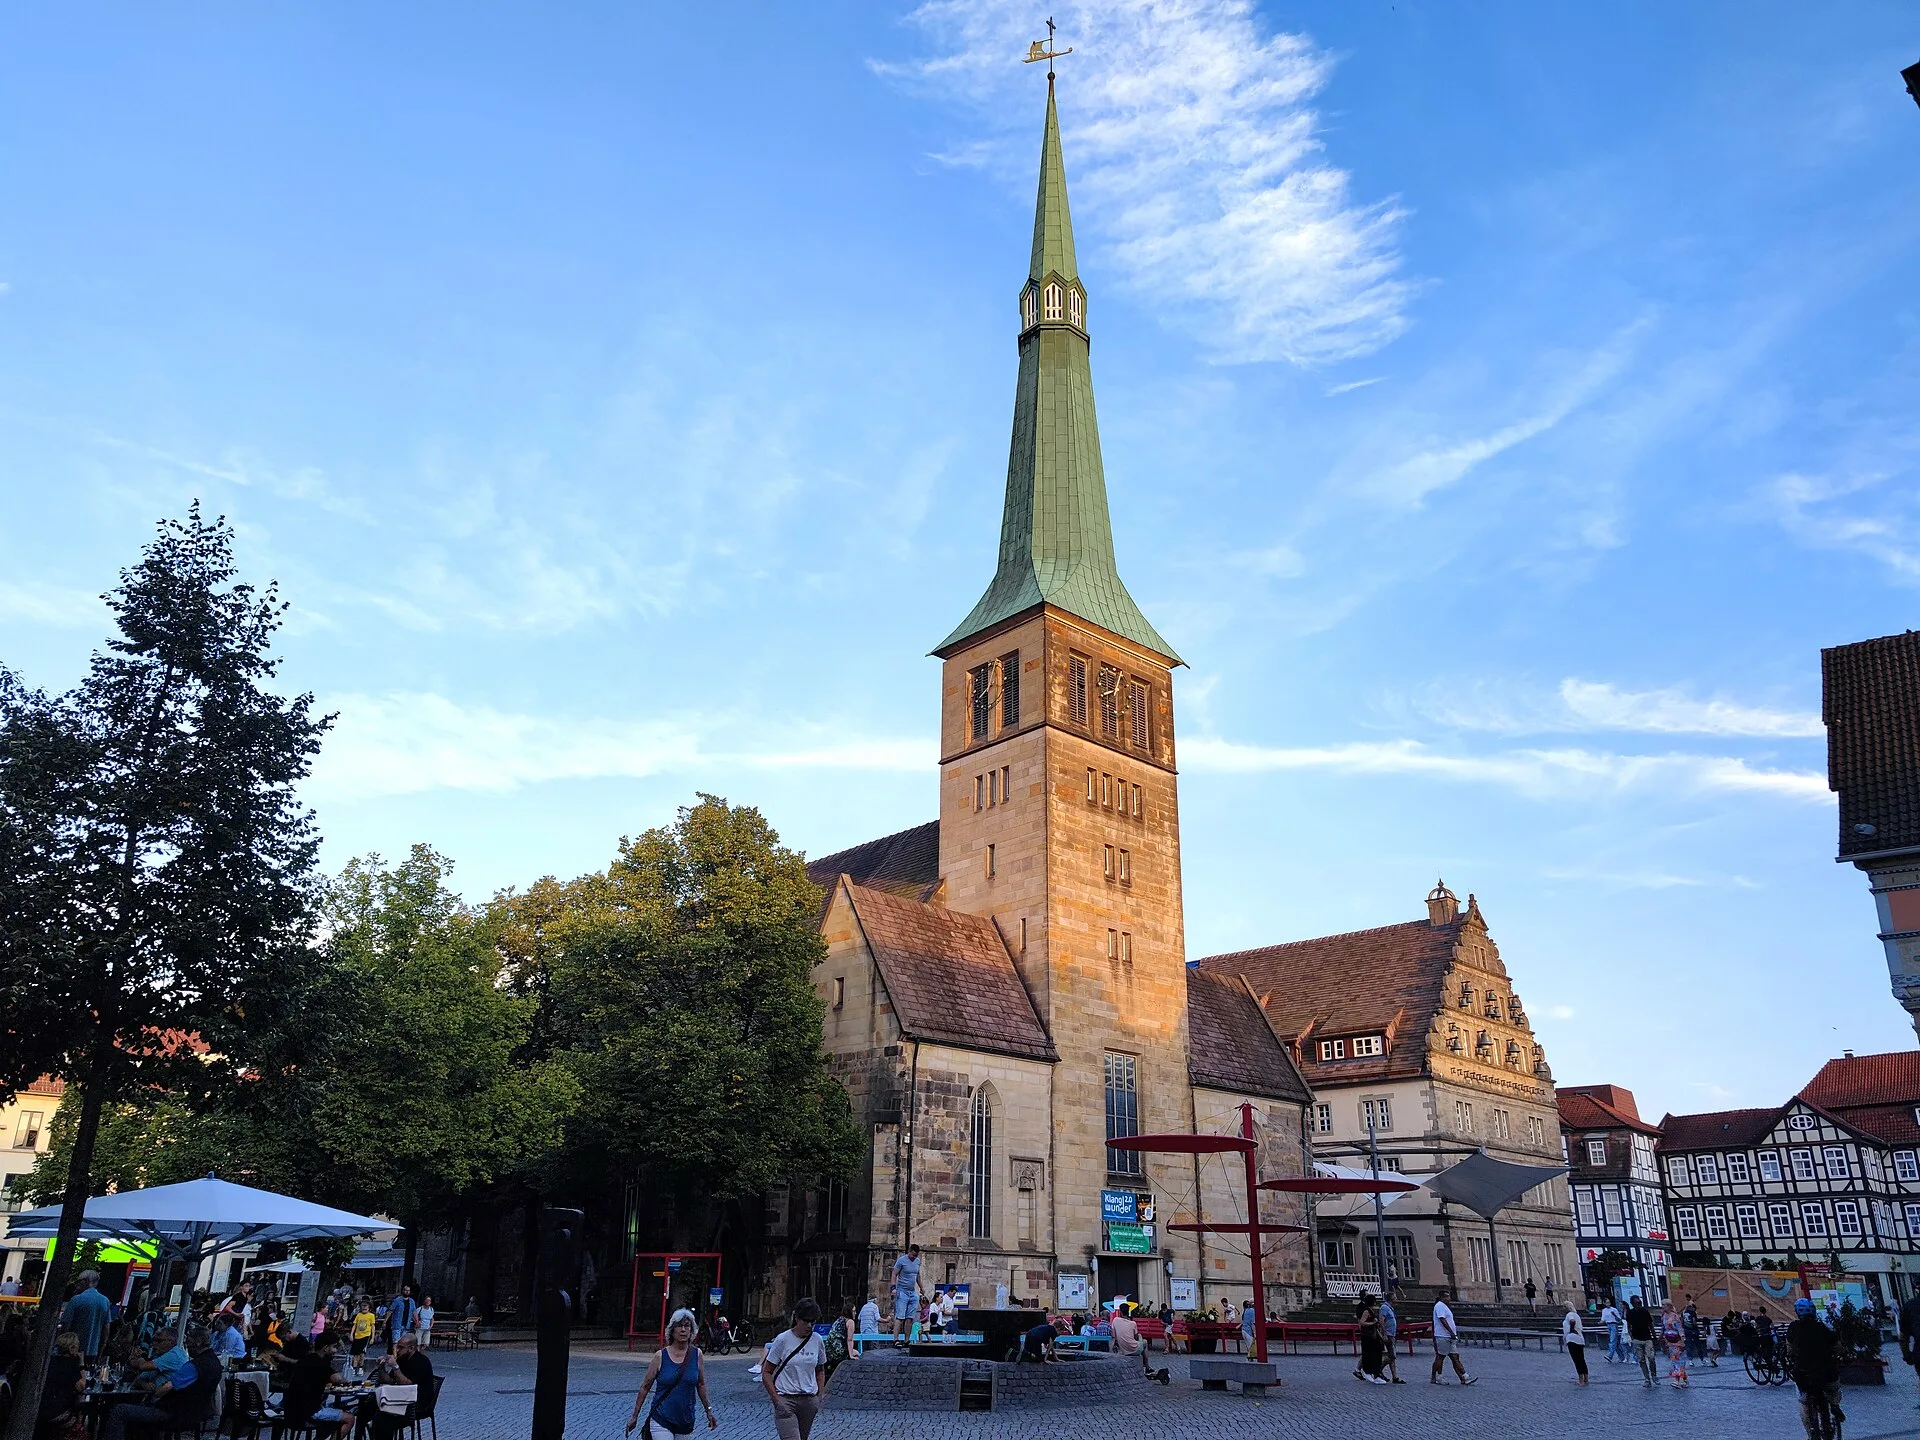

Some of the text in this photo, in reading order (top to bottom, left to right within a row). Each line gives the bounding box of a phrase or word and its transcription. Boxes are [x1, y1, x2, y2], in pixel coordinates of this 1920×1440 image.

[1104, 1194, 1132, 1206] Klang 2.0
[1104, 1197, 1132, 1214] wunder
